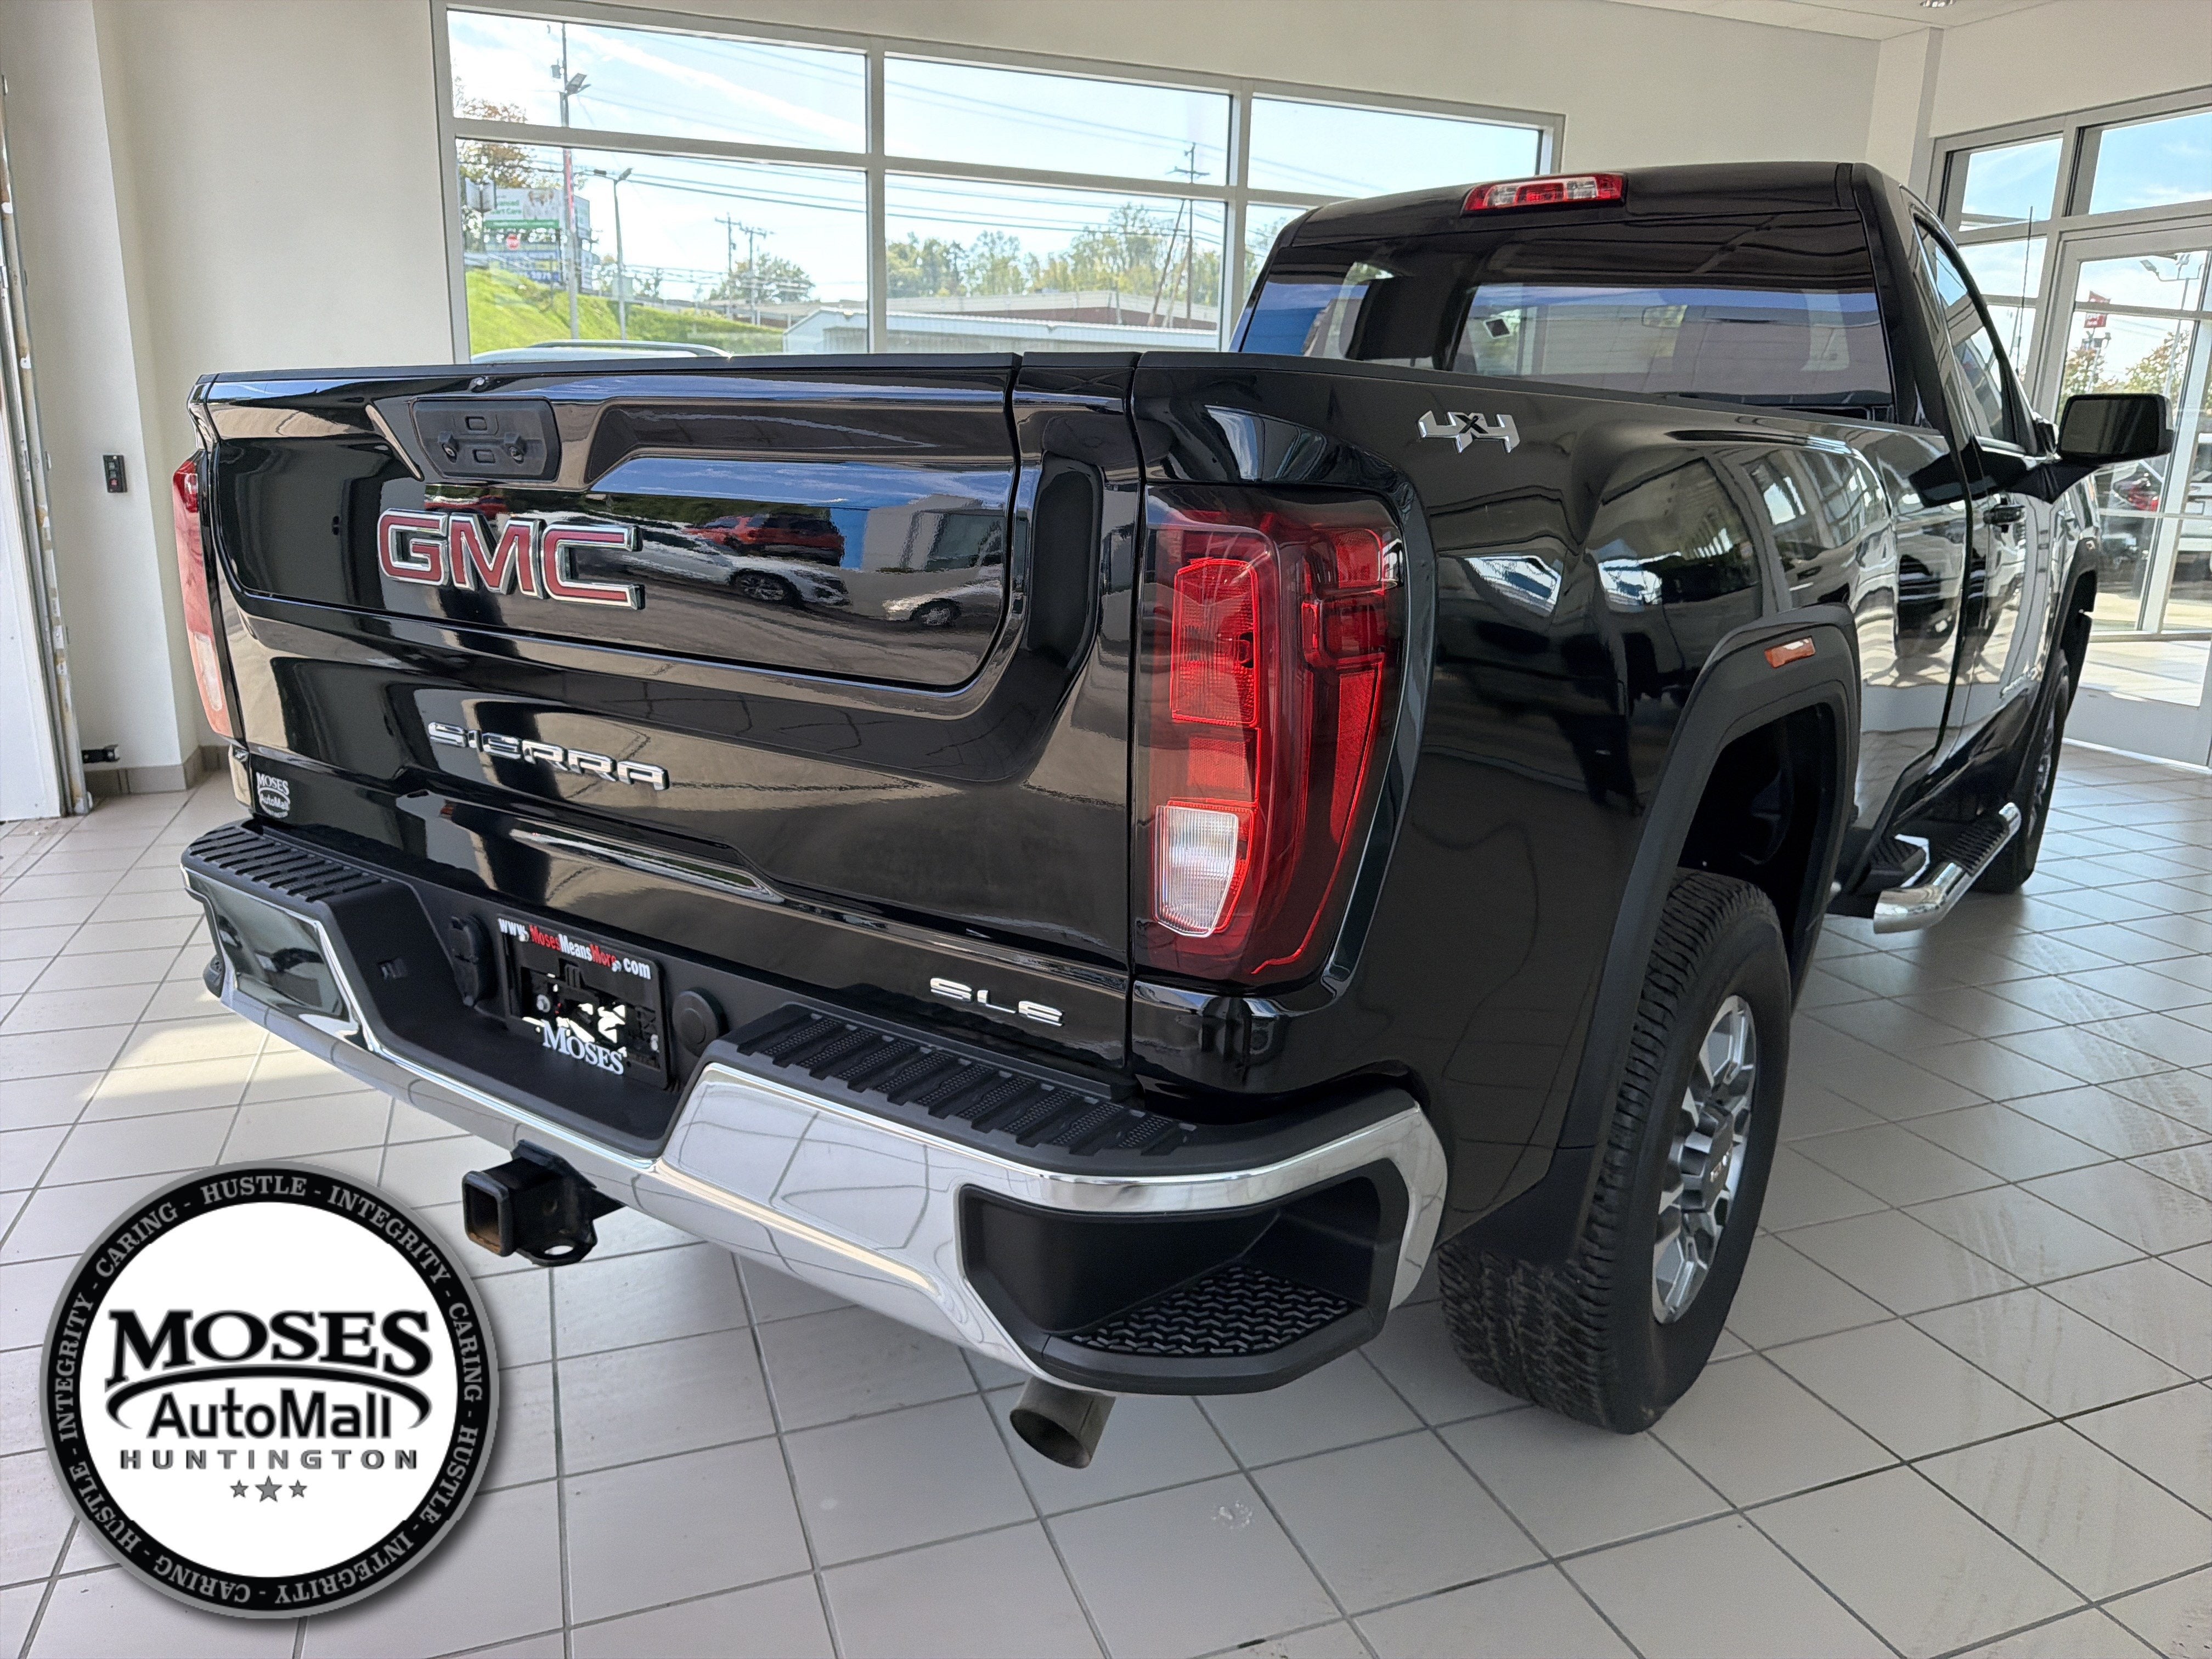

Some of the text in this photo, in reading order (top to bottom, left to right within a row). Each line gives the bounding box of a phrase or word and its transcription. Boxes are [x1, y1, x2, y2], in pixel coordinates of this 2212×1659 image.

[377, 507, 646, 610] GMC
[256, 771, 290, 795] MOSES
[428, 721, 670, 791] SIERRA
[497, 917, 652, 980] wwwMosesMeansMorecom
[930, 978, 1063, 1027] SLE
[541, 1018, 624, 1075] MOSES
